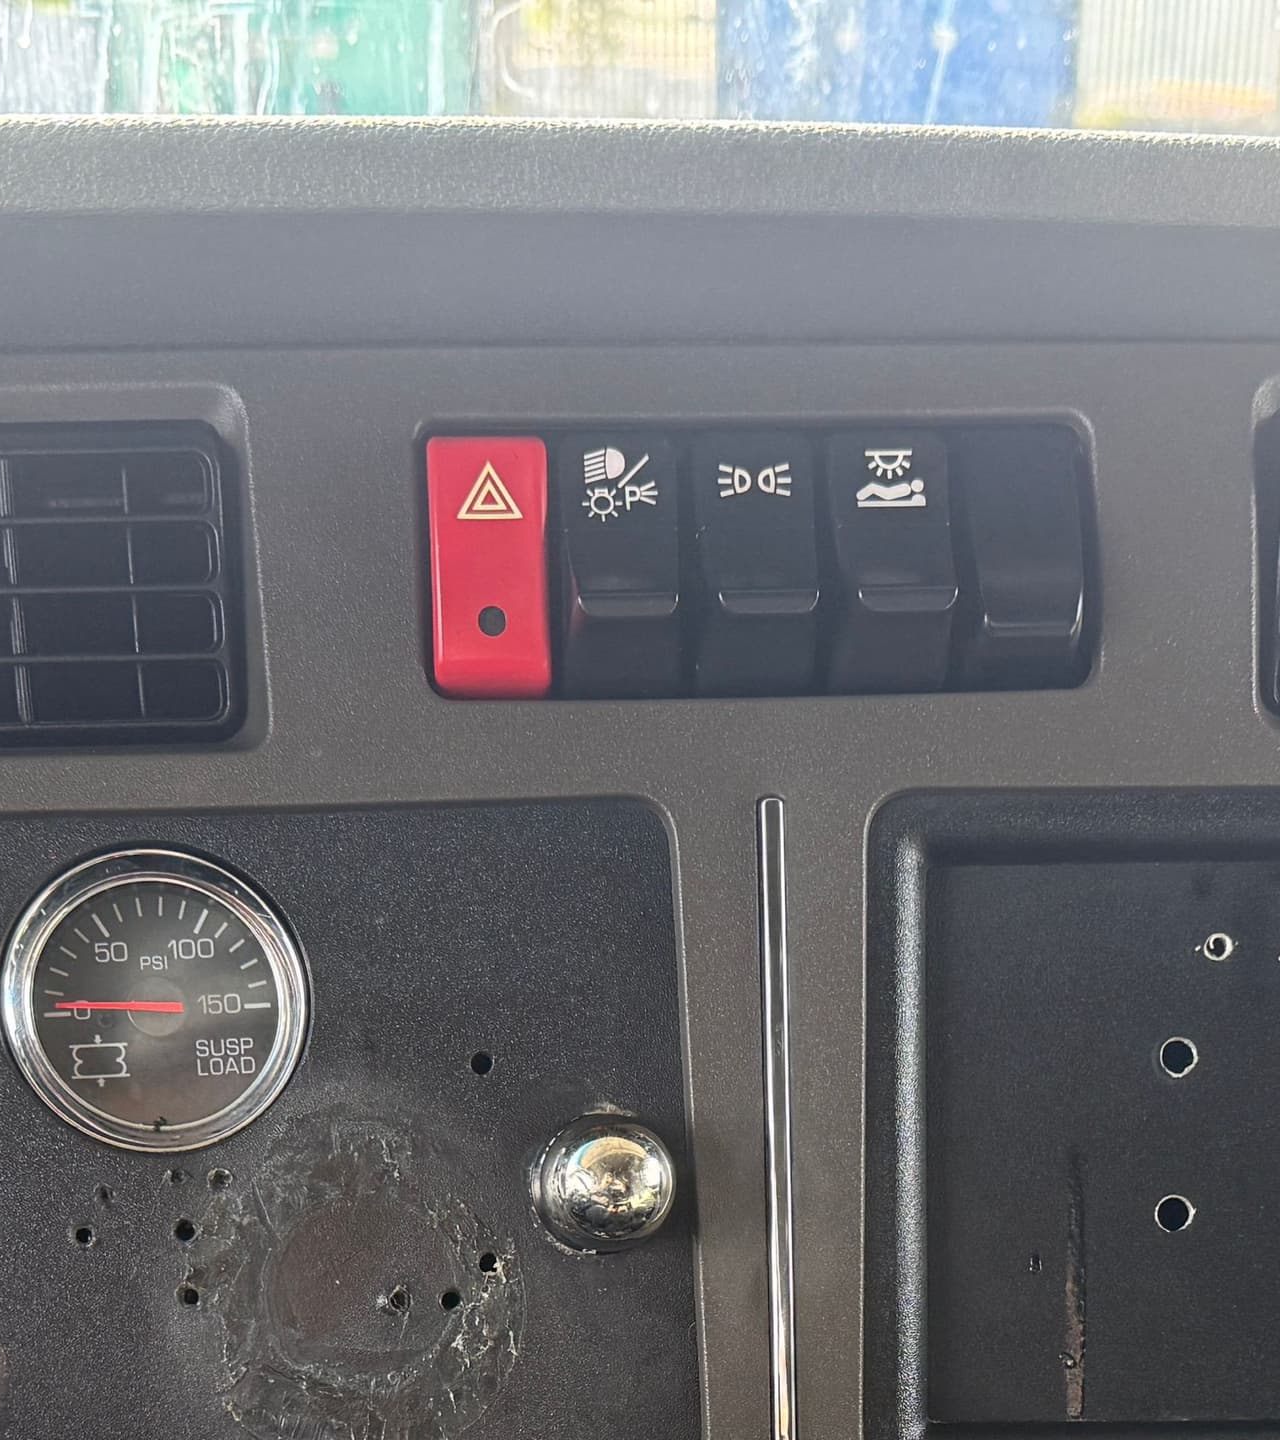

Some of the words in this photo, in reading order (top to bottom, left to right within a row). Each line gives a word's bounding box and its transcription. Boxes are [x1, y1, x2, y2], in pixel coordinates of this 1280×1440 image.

[94, 941, 128, 963] 50
[168, 938, 215, 961] 100
[139, 955, 169, 971] PSI
[198, 994, 242, 1015] 150
[195, 1038, 254, 1058] SUSP
[196, 1055, 256, 1077] LOAD
